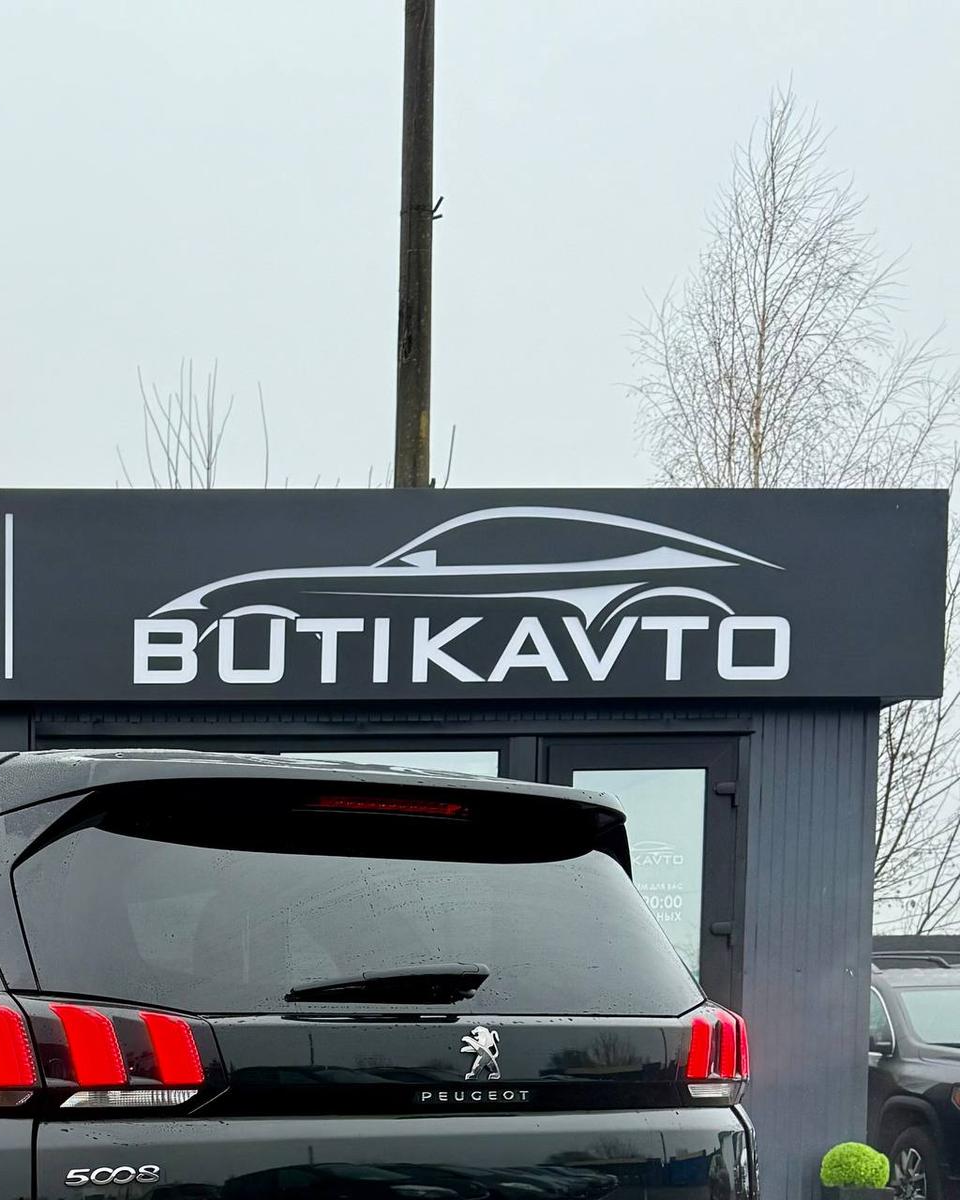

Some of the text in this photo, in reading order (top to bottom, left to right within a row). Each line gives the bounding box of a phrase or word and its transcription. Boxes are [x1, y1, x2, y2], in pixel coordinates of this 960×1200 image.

[133, 615, 791, 684] BUTIKAVTO
[633, 855, 684, 865] KAVTO
[421, 1090, 529, 1101] PEUGEOT
[65, 1164, 160, 1186] 5008
